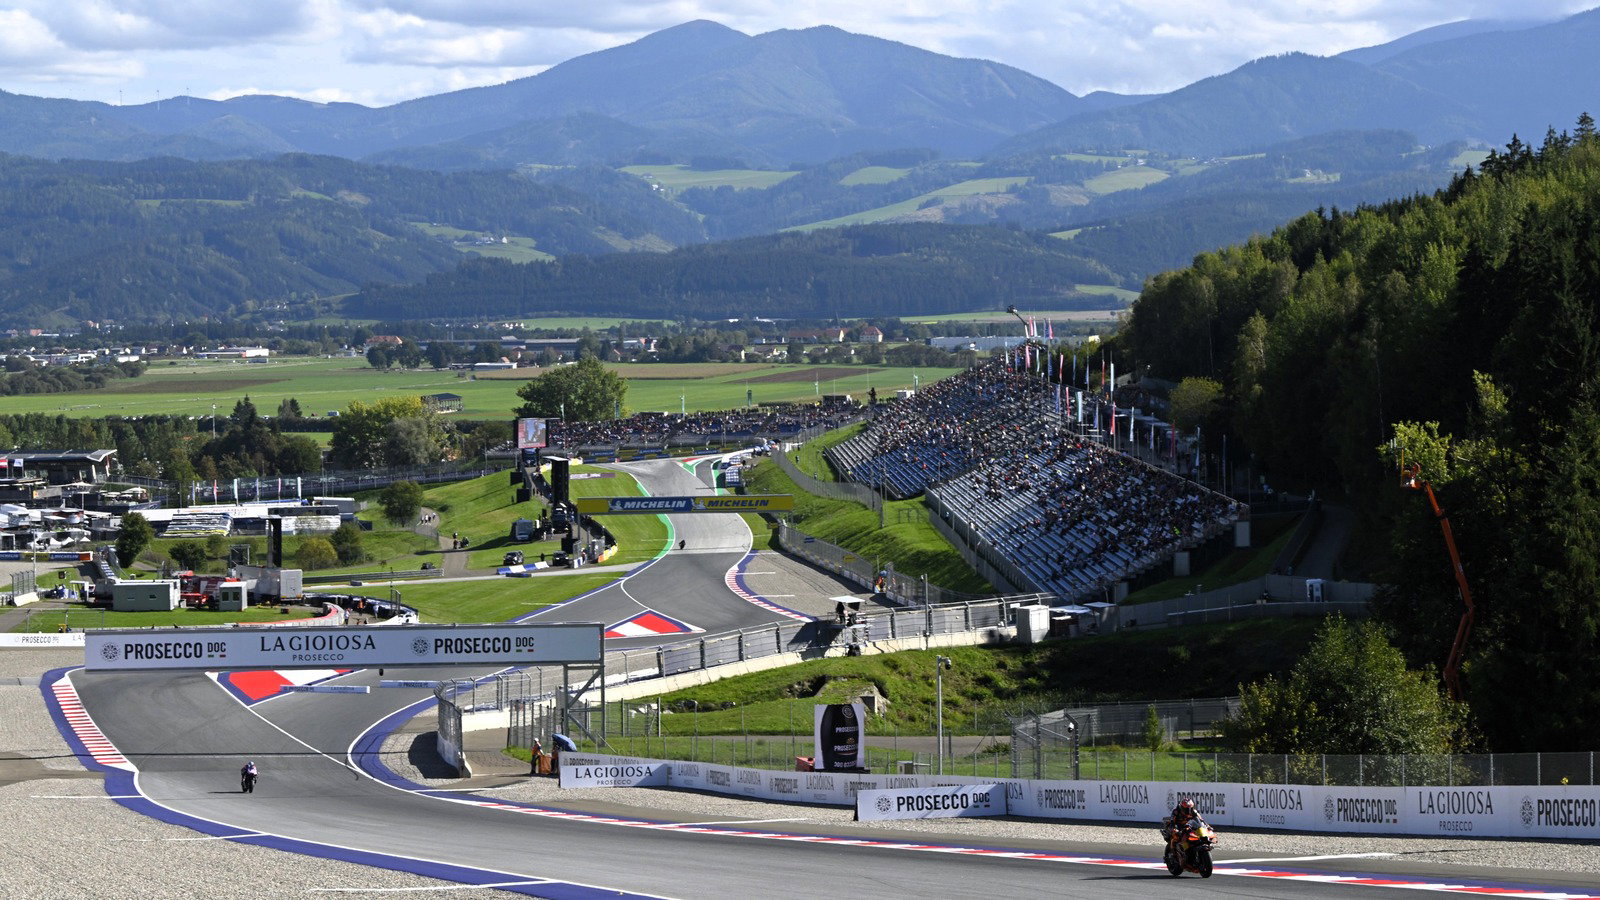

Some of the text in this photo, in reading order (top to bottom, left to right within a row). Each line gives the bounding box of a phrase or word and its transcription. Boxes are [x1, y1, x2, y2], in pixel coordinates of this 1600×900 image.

[624, 500, 686, 509] MICHELIN
[707, 499, 769, 508] MICHELIN
[22, 636, 52, 644] PROSECCO
[434, 637, 534, 654] PROSECCO DOC
[124, 642, 226, 660] PROSECCO DOC
[292, 653, 344, 662] PROSECCO
[897, 792, 990, 812] PROSECCO DOC
[1045, 789, 1076, 810] PROSECCO
[1177, 792, 1215, 815] PSECCO
[1259, 814, 1286, 825] PROSECCO
[1337, 798, 1397, 824] PROSECCO DOC
[1537, 798, 1596, 827] PROSECCO
[1439, 820, 1473, 832] PROSECCO
